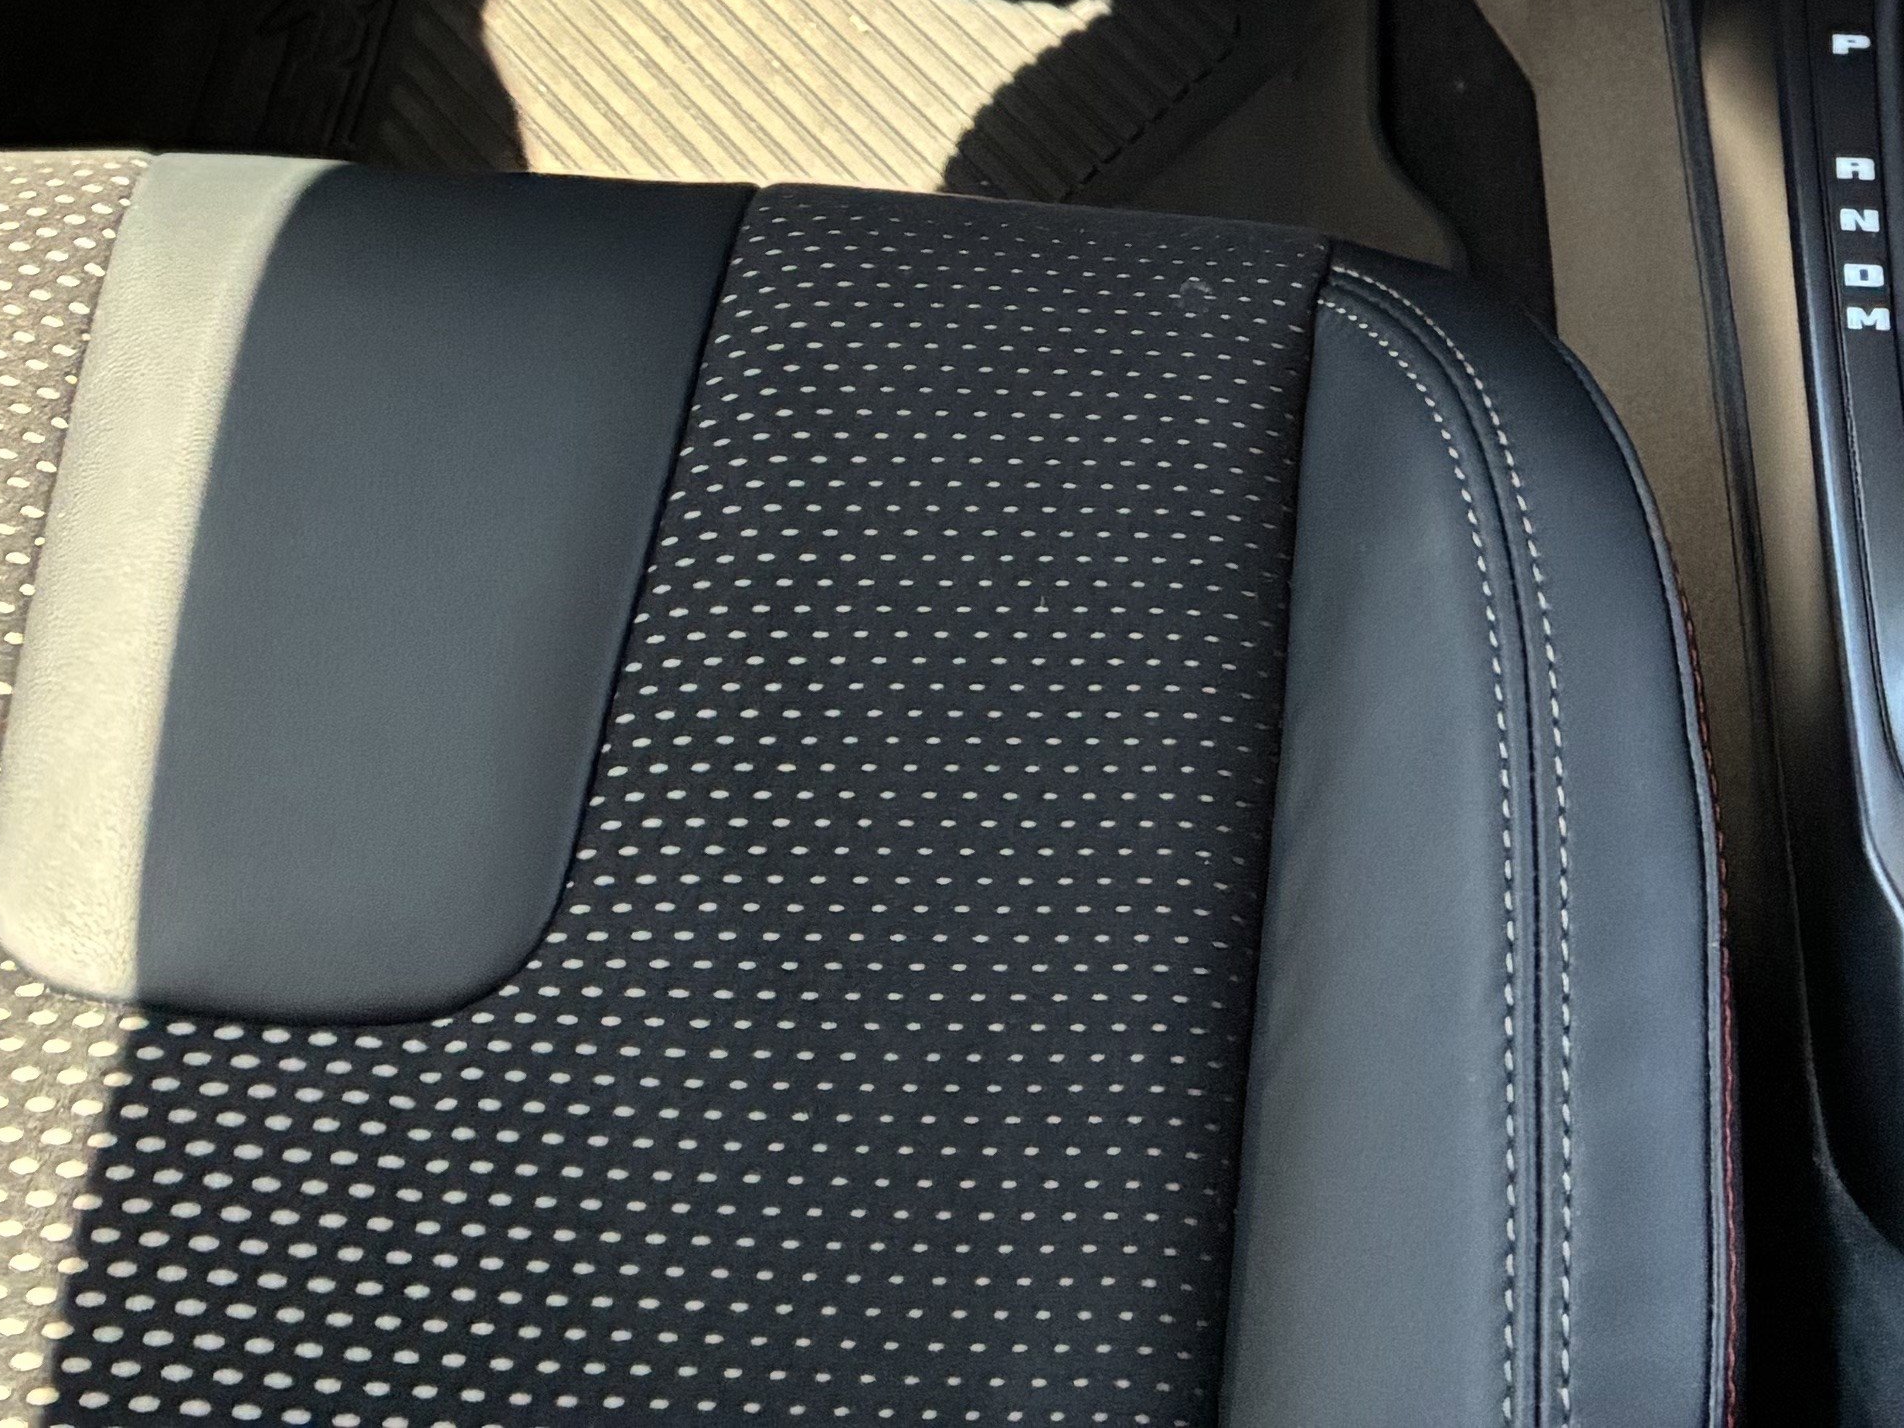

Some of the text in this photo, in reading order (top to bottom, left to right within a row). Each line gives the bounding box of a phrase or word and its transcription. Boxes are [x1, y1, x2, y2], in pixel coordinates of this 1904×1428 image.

[1832, 34, 1871, 55] P
[1836, 157, 1875, 181] R
[1839, 208, 1880, 233] N
[1844, 263, 1885, 288] D
[1846, 306, 1891, 332] M
